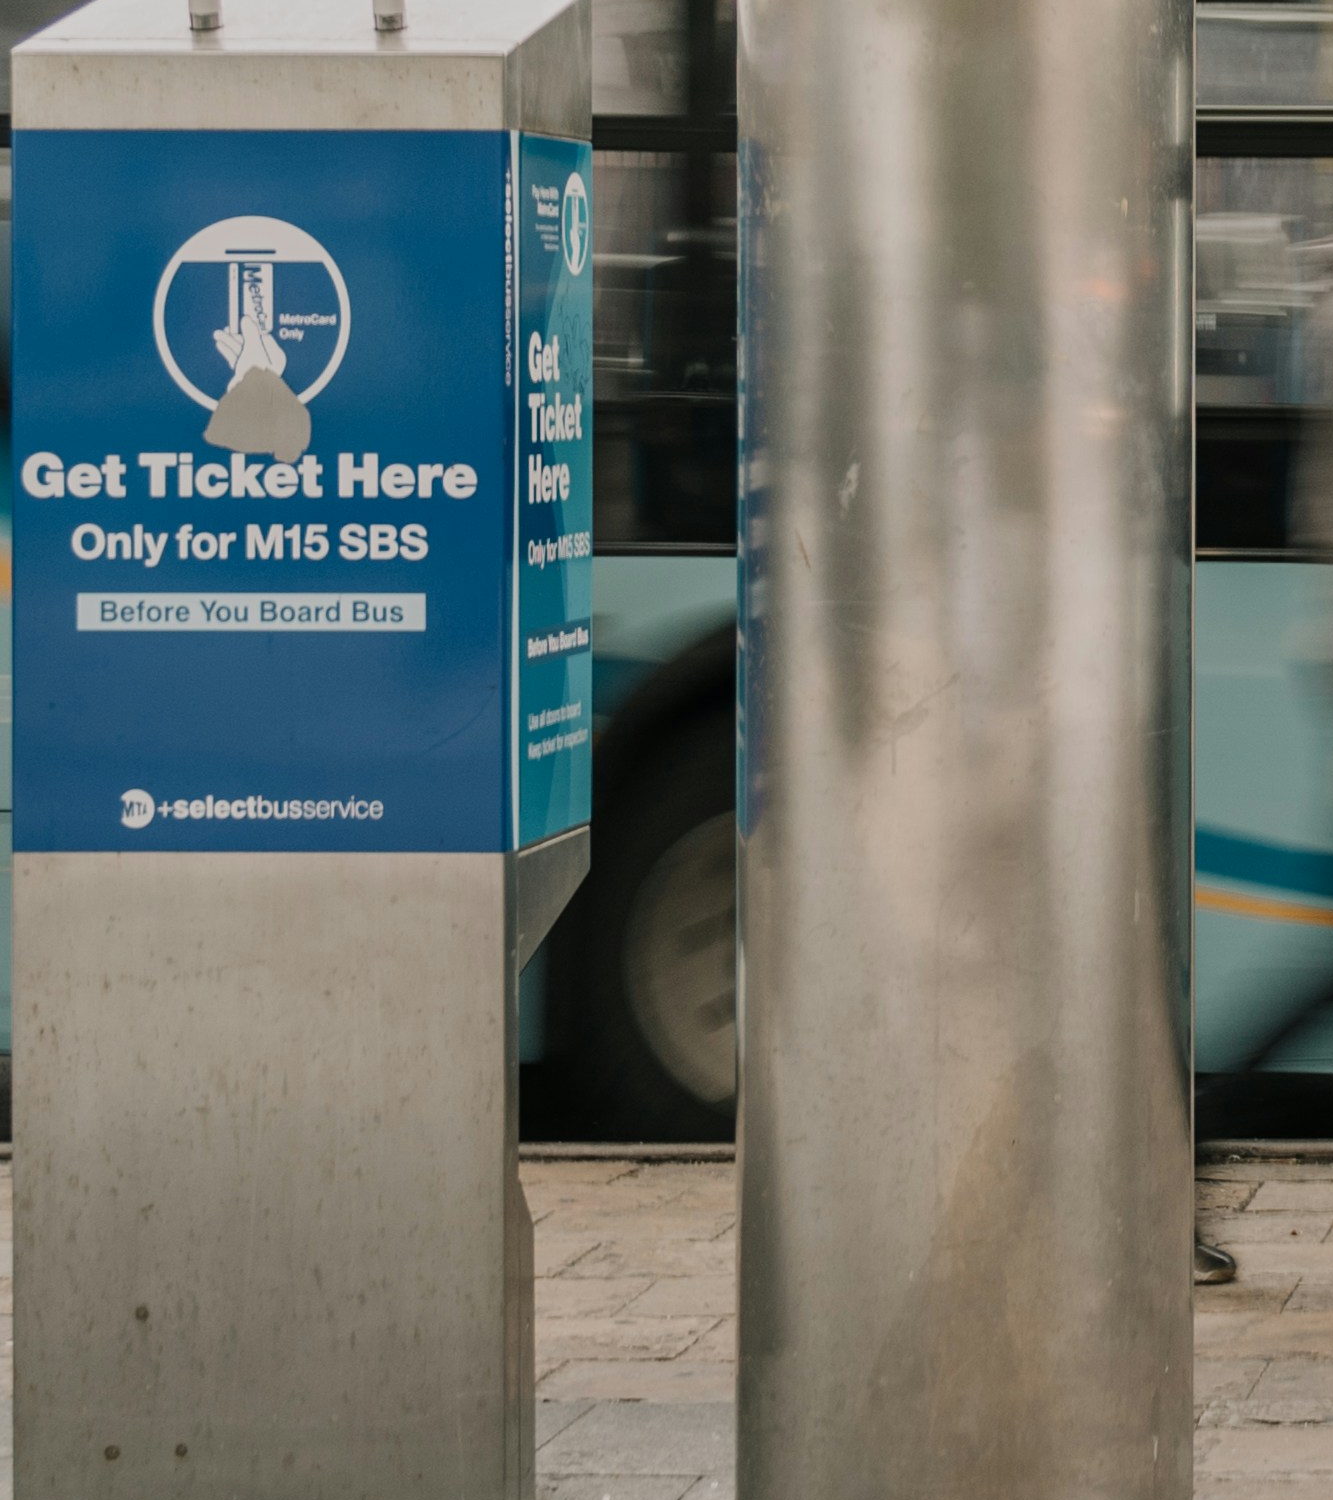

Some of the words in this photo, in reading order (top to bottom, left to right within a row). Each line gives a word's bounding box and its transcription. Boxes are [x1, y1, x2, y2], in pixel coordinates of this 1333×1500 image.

[278, 312, 337, 326] MetroCard
[278, 328, 304, 341] Only
[528, 331, 561, 383] Get
[528, 392, 583, 443] Ticket
[20, 451, 127, 499] Get
[138, 452, 323, 499] Ticket
[337, 453, 479, 499] Here
[528, 453, 570, 505] Here
[71, 523, 168, 568] Only
[175, 523, 236, 560] for
[245, 523, 329, 560] M15
[338, 523, 429, 561] SBS
[528, 539, 546, 570] Only
[546, 538, 558, 562] for
[558, 534, 573, 560] M15
[574, 531, 591, 558] SBS
[100, 600, 191, 623] Before
[199, 600, 249, 623] You
[260, 600, 341, 623] Board
[352, 600, 404, 623] Bus
[527, 636, 547, 658] Before
[547, 633, 560, 653] You
[560, 628, 576, 650] Board
[577, 626, 589, 647] Bus
